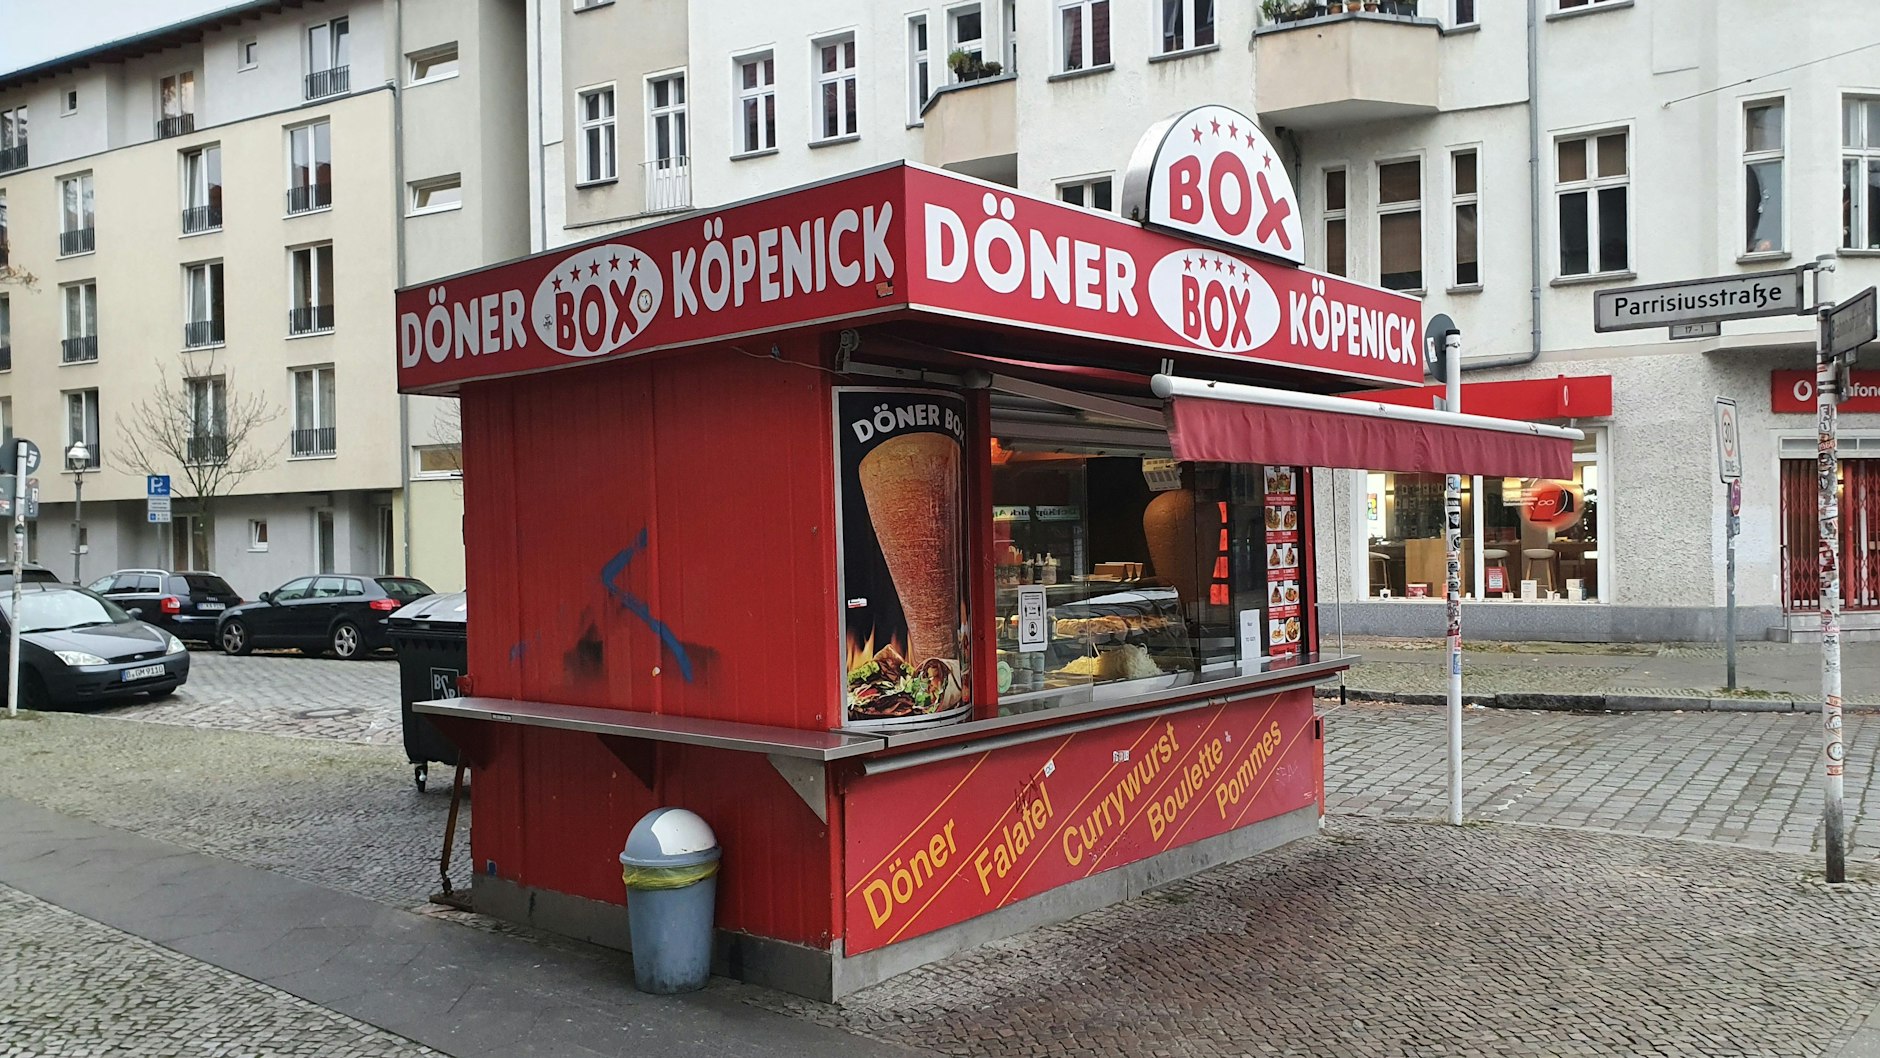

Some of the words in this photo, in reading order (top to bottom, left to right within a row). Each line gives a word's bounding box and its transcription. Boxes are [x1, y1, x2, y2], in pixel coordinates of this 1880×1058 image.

[1169, 150, 1292, 251] BOX
[400, 286, 528, 369] DÖNER
[555, 274, 637, 353] BOX
[672, 201, 895, 318] KÖPENICK
[924, 192, 1138, 317] DÖNER
[1182, 273, 1252, 349] BOX
[1289, 277, 1417, 366] KÖPENICK
[1614, 283, 1782, 317] Parrisiusstraße
[851, 402, 940, 443] DÖNER
[944, 407, 965, 447] BOX
[1062, 721, 1181, 866] Currywurst
[1146, 737, 1224, 842] Boulette
[1215, 719, 1283, 820] Pommes
[862, 819, 958, 929] Döner
[973, 782, 1055, 895] Falafel
